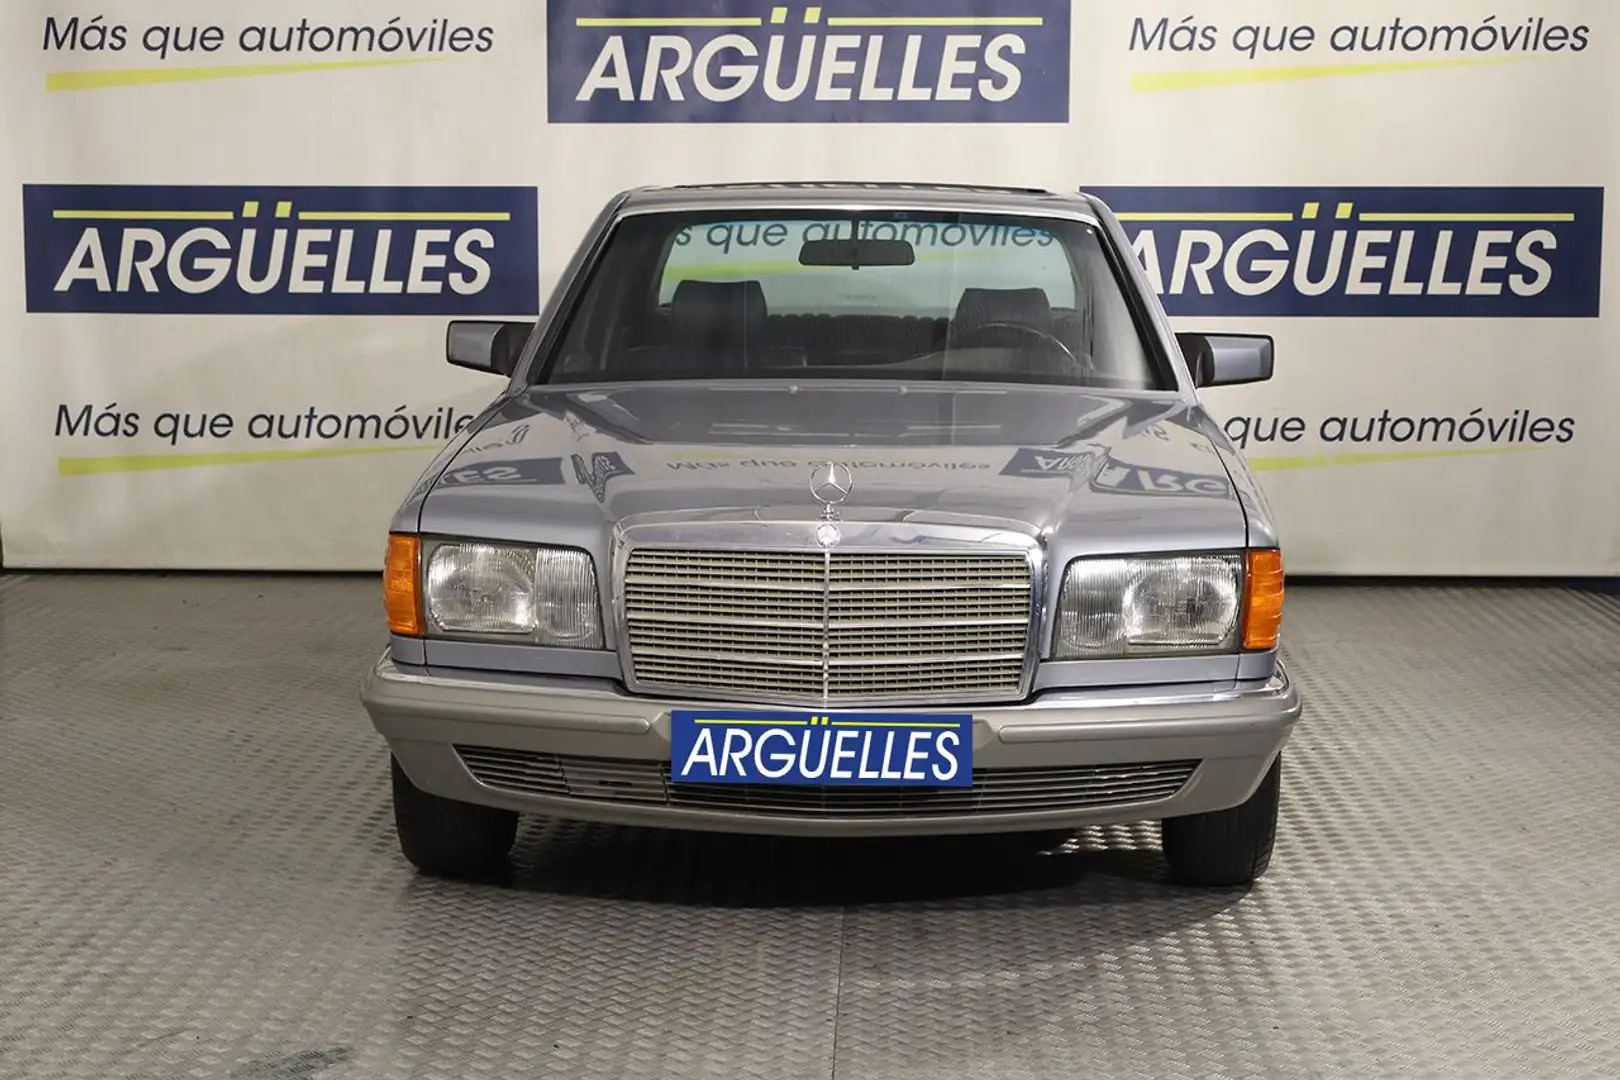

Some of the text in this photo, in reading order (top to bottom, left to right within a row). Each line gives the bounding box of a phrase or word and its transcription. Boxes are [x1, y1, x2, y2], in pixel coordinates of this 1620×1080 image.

[42, 14, 494, 60] Más que automóviles
[575, 6, 1028, 103] ARGÜELLES
[1129, 15, 1590, 59] Más que automóviles
[53, 201, 495, 295] ARGÜELLES
[706, 222, 789, 255] que
[1130, 202, 1557, 296] ARGÜELLES
[54, 401, 140, 438] Más
[153, 412, 234, 446] que
[1223, 407, 1576, 450] que automóviles
[680, 716, 961, 781] ARGÜELLES
